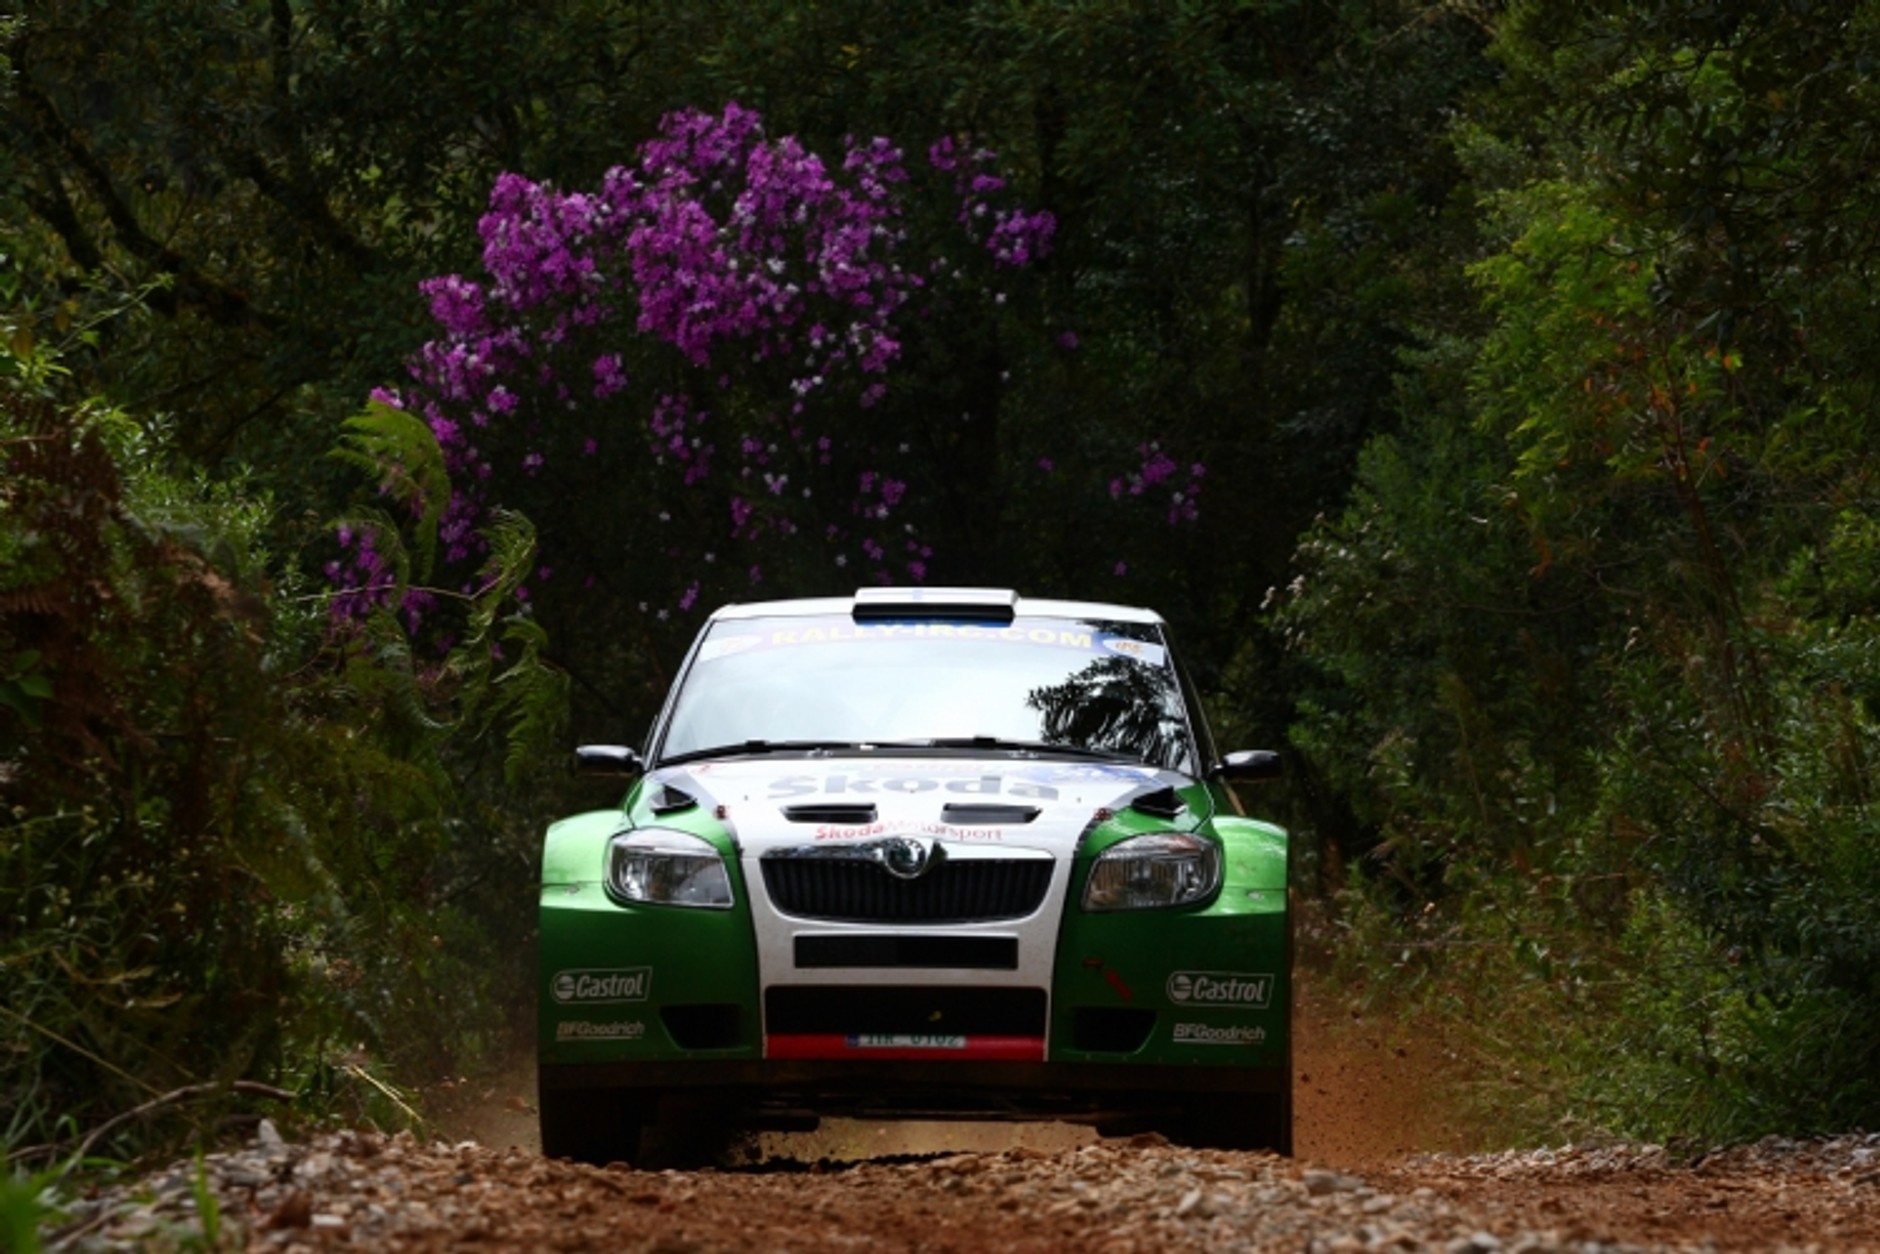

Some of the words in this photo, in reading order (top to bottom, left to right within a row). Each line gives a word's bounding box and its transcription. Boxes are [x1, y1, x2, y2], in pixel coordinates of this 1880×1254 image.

[576, 973, 644, 998] Castrol
[1193, 976, 1265, 1001] Castrol
[556, 1021, 645, 1036] BFGoodrich
[1173, 1023, 1266, 1040] BFGoodrich
